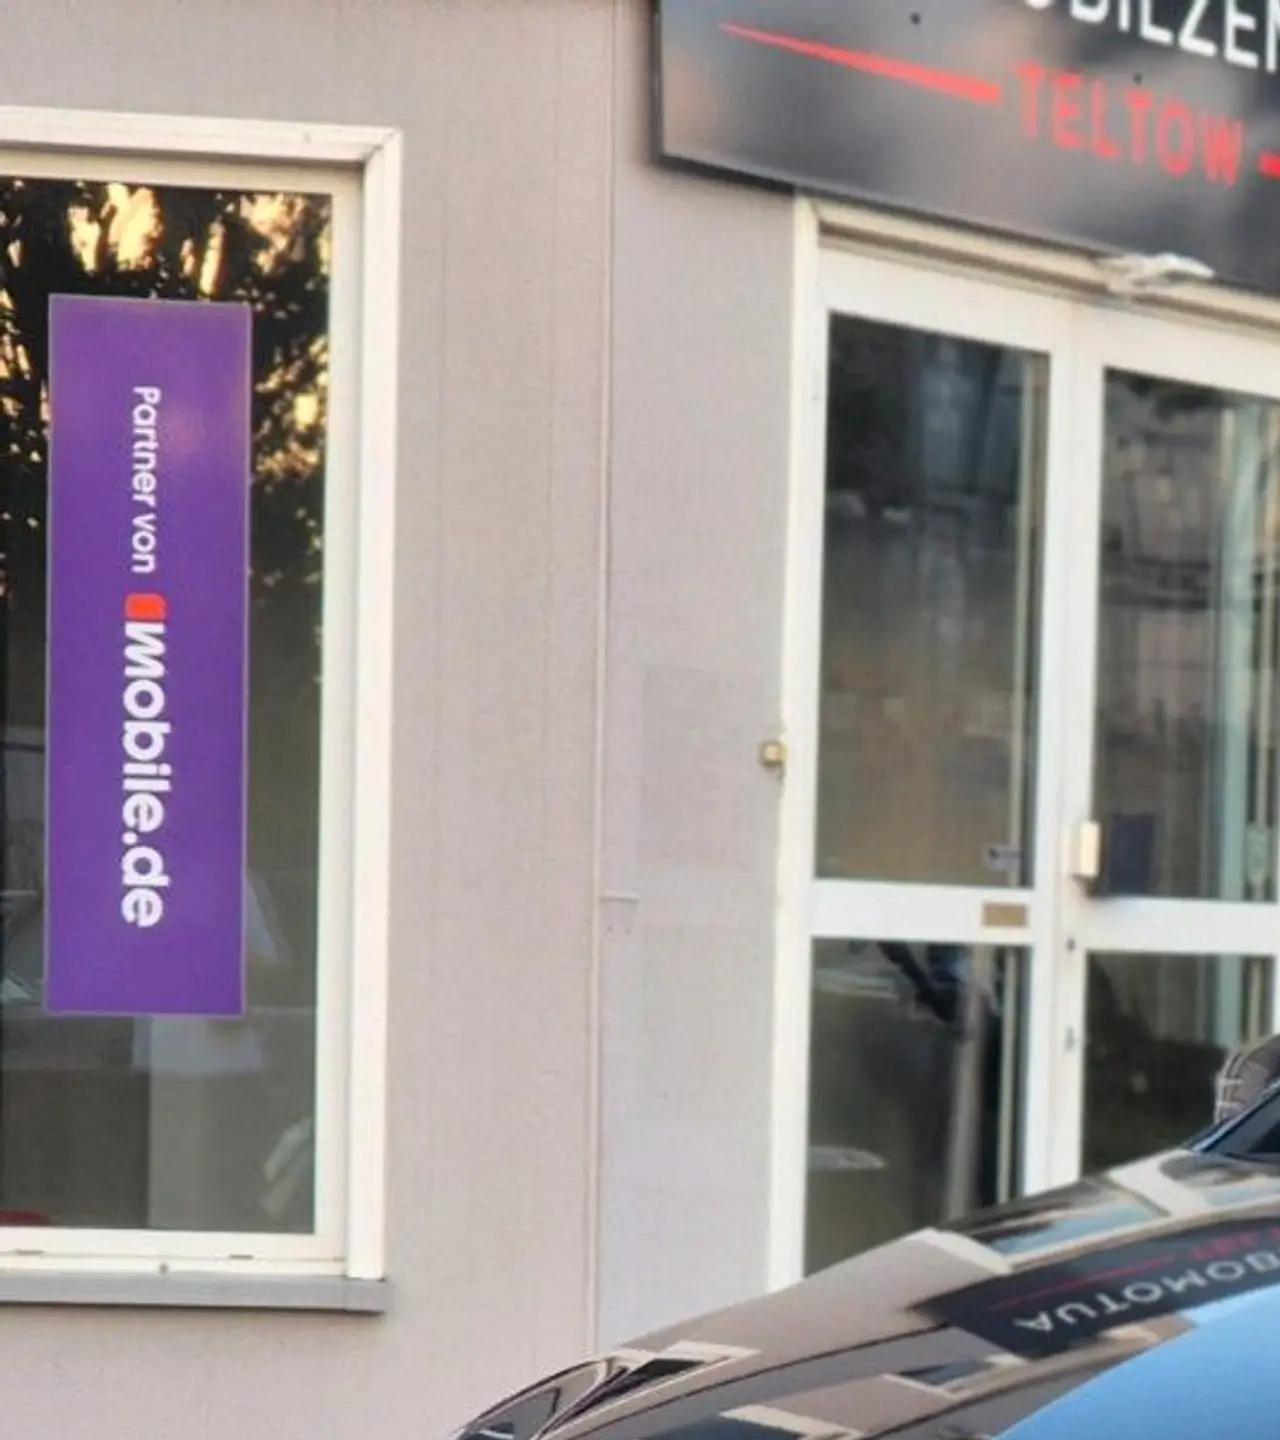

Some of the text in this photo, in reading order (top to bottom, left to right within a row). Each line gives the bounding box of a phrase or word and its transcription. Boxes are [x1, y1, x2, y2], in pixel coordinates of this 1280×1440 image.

[1011, 58, 1245, 187] TELTOW
[121, 386, 172, 929] Partner von mobile.de
